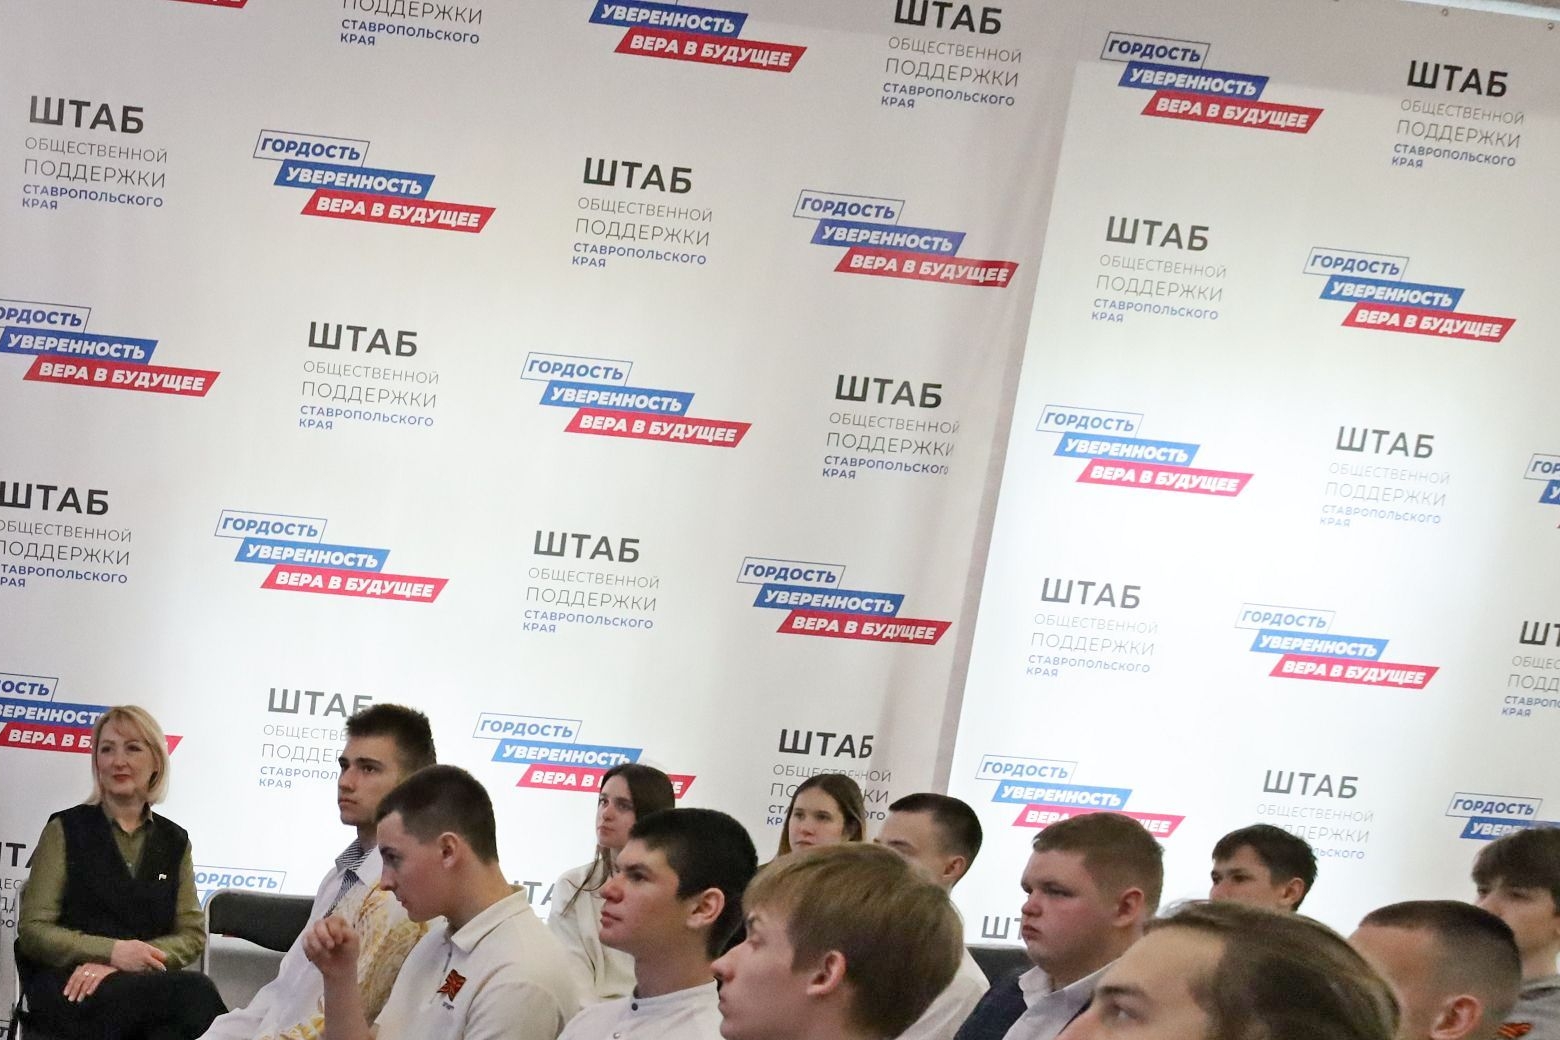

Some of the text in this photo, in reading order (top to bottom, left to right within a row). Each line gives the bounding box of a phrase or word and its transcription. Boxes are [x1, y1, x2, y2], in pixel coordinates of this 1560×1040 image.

[894, 0, 1002, 35] ШТАБ
[889, 36, 1021, 62] ОБЩЕСТВЕННОЙ
[1109, 40, 1200, 62] ГОРДОСТЬ
[886, 58, 1018, 87] ПОДДЕРЖКИ
[1130, 69, 1256, 96] УВЕРЕННОСТЬ
[1407, 60, 1508, 98] ШТАБ
[881, 96, 915, 108] КРАЯ
[883, 82, 1015, 106] СТАВРОПОЛЬСКОГО
[1156, 98, 1308, 128] ВЕРА В БУДУЩЕЕ
[1401, 100, 1524, 124] ОБЩЕСТВЕННОЙ
[1397, 120, 1520, 148] ПОДДЕРЖКИ
[262, 138, 360, 160] ГОРДОСТЬ
[1394, 143, 1516, 167] СТАВРОПОЛЬСКОГО
[1392, 156, 1423, 168] КРАЯ
[286, 167, 422, 194] УВЕРЕННОСТЬ
[583, 157, 692, 194] ШТАБ
[317, 197, 480, 227] ВЕРА В БУДУЩЕЕ
[578, 197, 712, 222] ОБЩЕСТВЕННОЙ
[801, 198, 894, 219] ГОРДОСТЬ
[576, 218, 709, 246] ПОДДЕРЖКИ
[822, 226, 952, 251] УВЕРЕННОСТЬ
[1106, 216, 1210, 252] ШТАБ
[572, 256, 606, 267] КРАЯ
[574, 242, 706, 265] СТАВРОПОЛЬСКОГО
[1312, 256, 1399, 275] ГОРДОСТЬ
[850, 255, 1008, 282] ВЕРА В БУДУЩЕЕ
[1100, 254, 1226, 278] ОБЩЕСТВЕННОЙ
[1096, 274, 1222, 301] ПОДДЕРЖКИ
[1331, 282, 1452, 306] УВЕРЕННОСТЬ
[1092, 312, 1124, 322] КРАЯ
[1094, 298, 1218, 320] СТАВРОПОЛЬСКОГО
[1355, 310, 1502, 337] ВЕРА В БУДУЩЕЕ
[8, 334, 144, 359] УВЕРЕННОСТЬ
[308, 321, 418, 357] ШТАБ
[39, 363, 205, 391] ВЕРА В БУДУЩЕЕ
[304, 361, 438, 384] ОБЩЕСТВЕННОЙ
[529, 360, 623, 380] ГОРДОСТЬ
[302, 381, 436, 408] ПОДДЕРЖКИ
[551, 387, 682, 411] УВЕРЕННОСТЬ
[299, 418, 333, 430] КРАЯ
[300, 405, 434, 426] СТАВРОПОЛЬСКОГО
[1045, 412, 1133, 431] ГОРДОСТЬ
[580, 415, 737, 442] ВЕРА В БУДУЩЕЕ
[1065, 439, 1188, 462] УВЕРЕННОСТЬ
[1090, 466, 1240, 492] ВЕРА В БУДУЩЕЕ
[223, 518, 318, 536] ГОРДОСТЬ
[247, 544, 378, 568] УВЕРЕННОСТЬ
[276, 572, 434, 598] ВЕРА В БУДУЩЕЕ
[744, 564, 836, 583] ГОРДОСТЬ
[765, 590, 894, 612] УВЕРЕННОСТЬ
[792, 616, 936, 640] ВЕРА В БУДУЩЕЕ
[1242, 611, 1326, 628] ГОРДОСТЬ
[1260, 635, 1377, 656] УВЕРЕННОСТЬ
[1282, 661, 1426, 684] ВЕРА В БУДУЩЕЕ
[1263, 769, 1359, 799] ШТАБ
[1453, 798, 1534, 816] ГОРДОСТЬ
